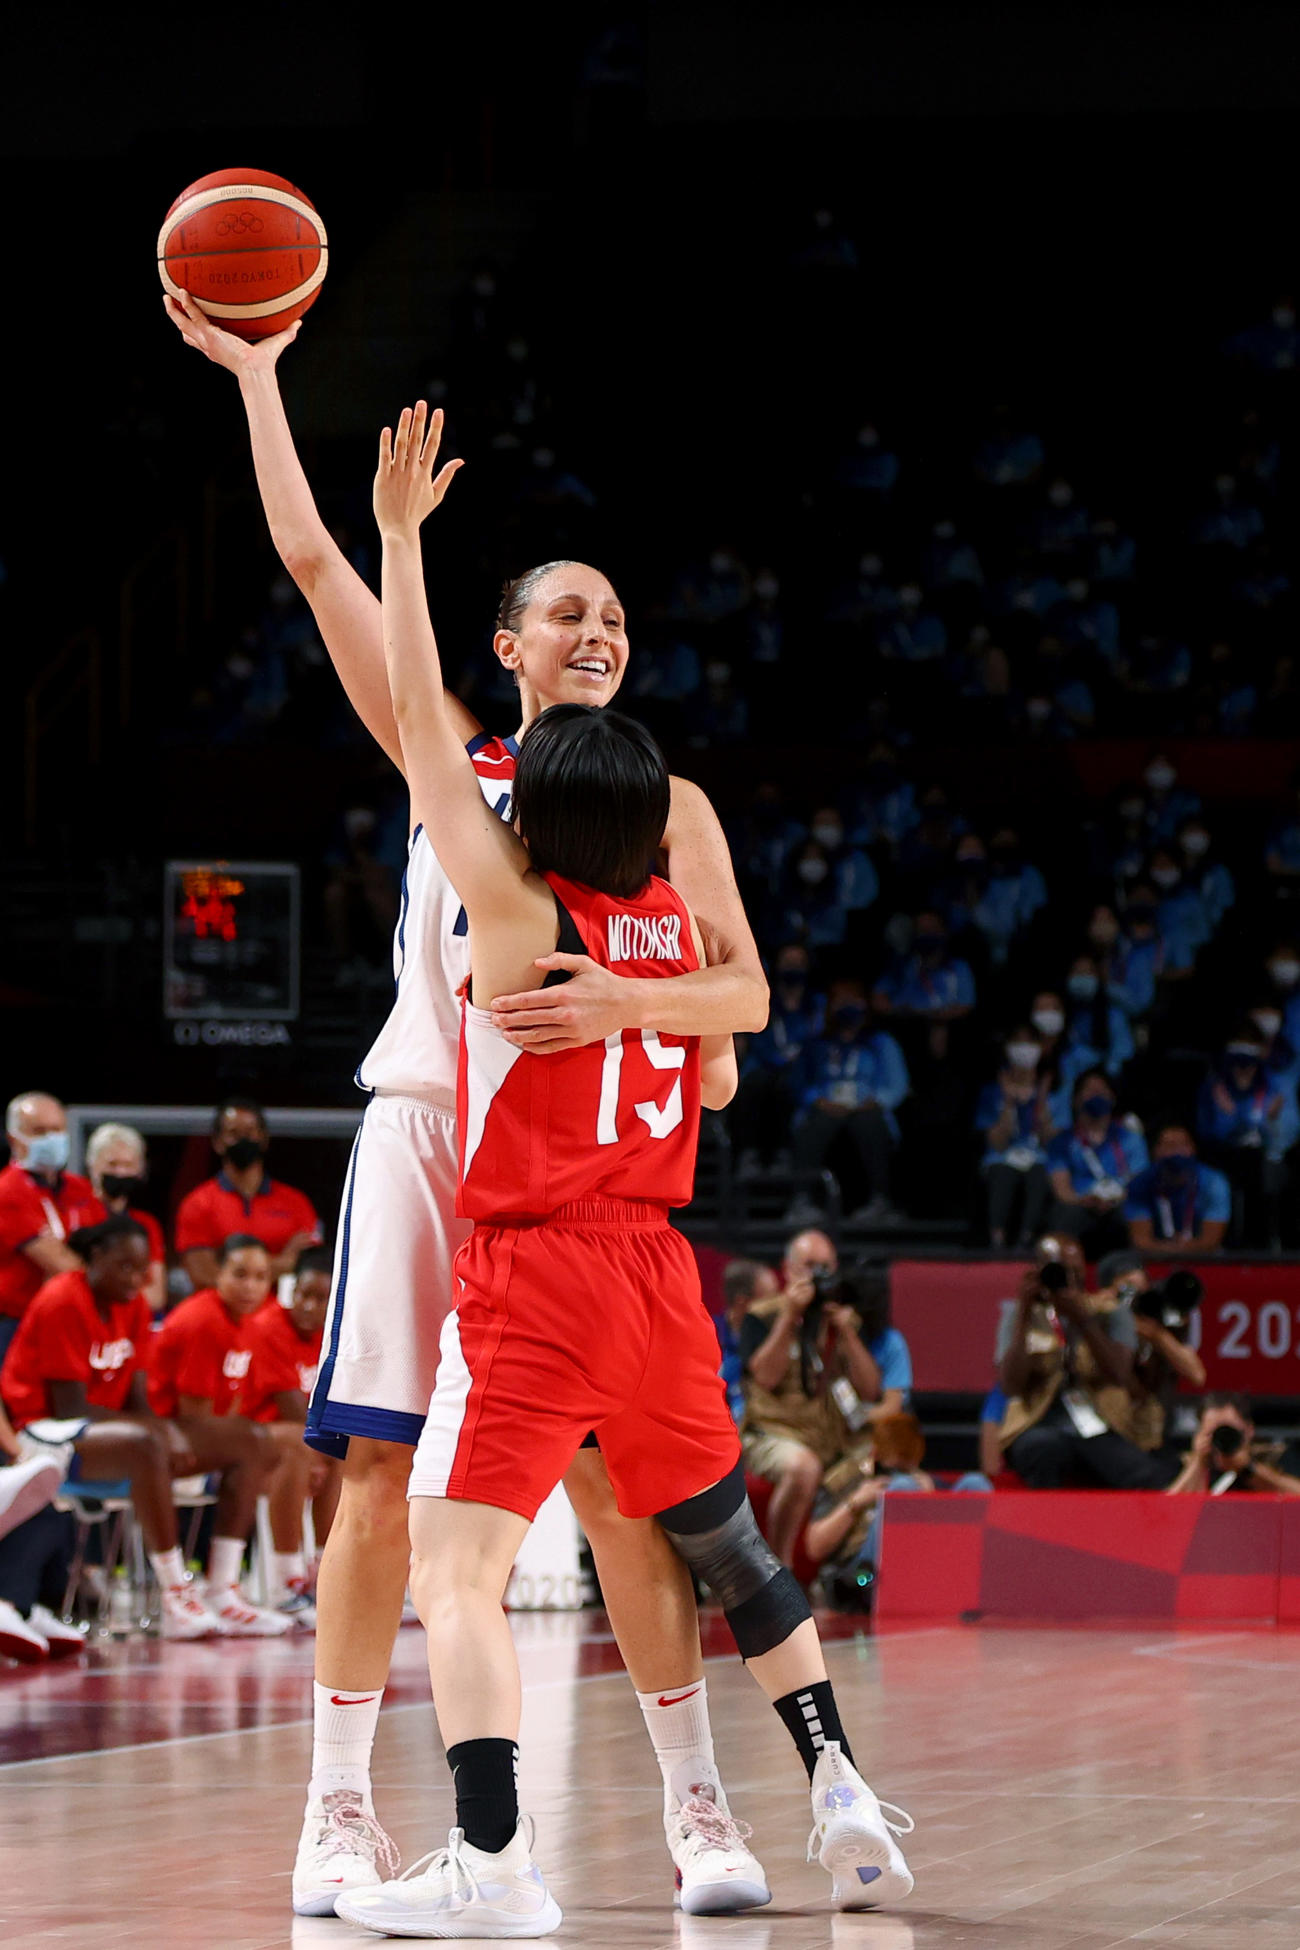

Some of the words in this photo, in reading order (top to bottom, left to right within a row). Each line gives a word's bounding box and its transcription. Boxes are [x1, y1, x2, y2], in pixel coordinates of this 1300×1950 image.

[596, 1028, 687, 1146] 15
[1217, 1299, 1300, 1360] 20
[515, 1573, 579, 1608] 020
[829, 1744, 841, 1776] CURRY
